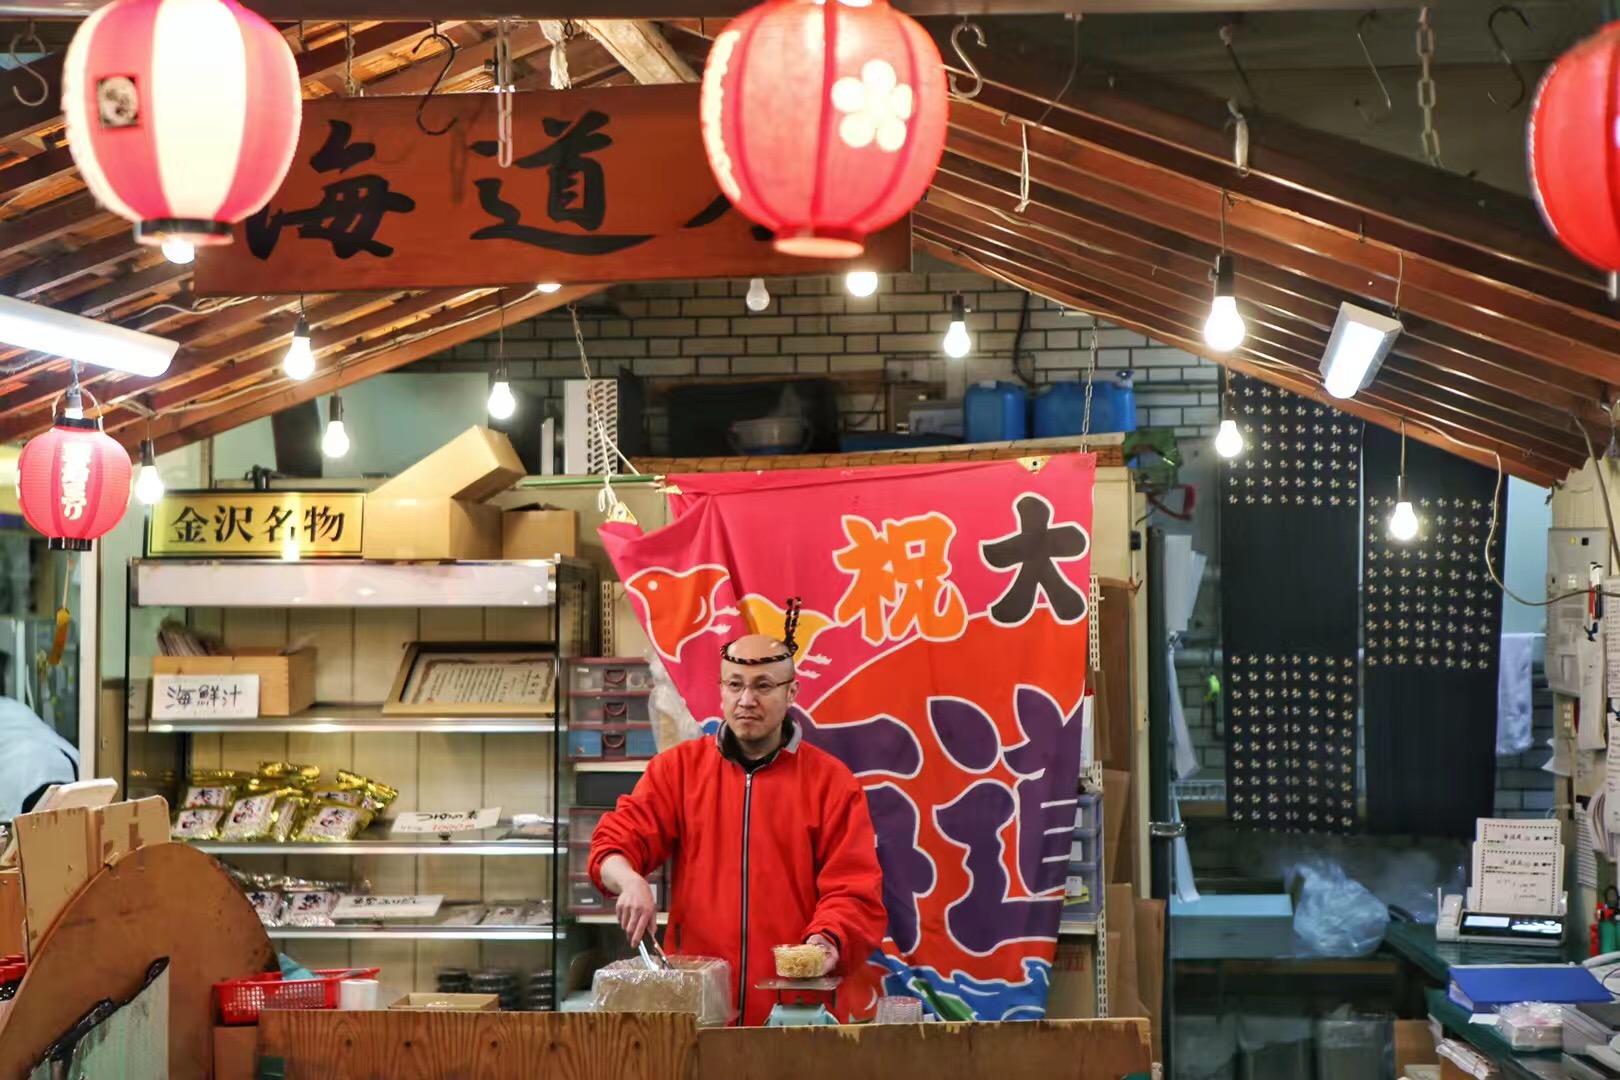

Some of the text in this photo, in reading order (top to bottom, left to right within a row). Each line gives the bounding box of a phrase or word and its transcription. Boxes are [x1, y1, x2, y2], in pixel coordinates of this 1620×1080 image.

[246, 110, 775, 260] 海道
[168, 504, 346, 544] 金沢名物
[164, 683, 243, 709] 海鮮汁
